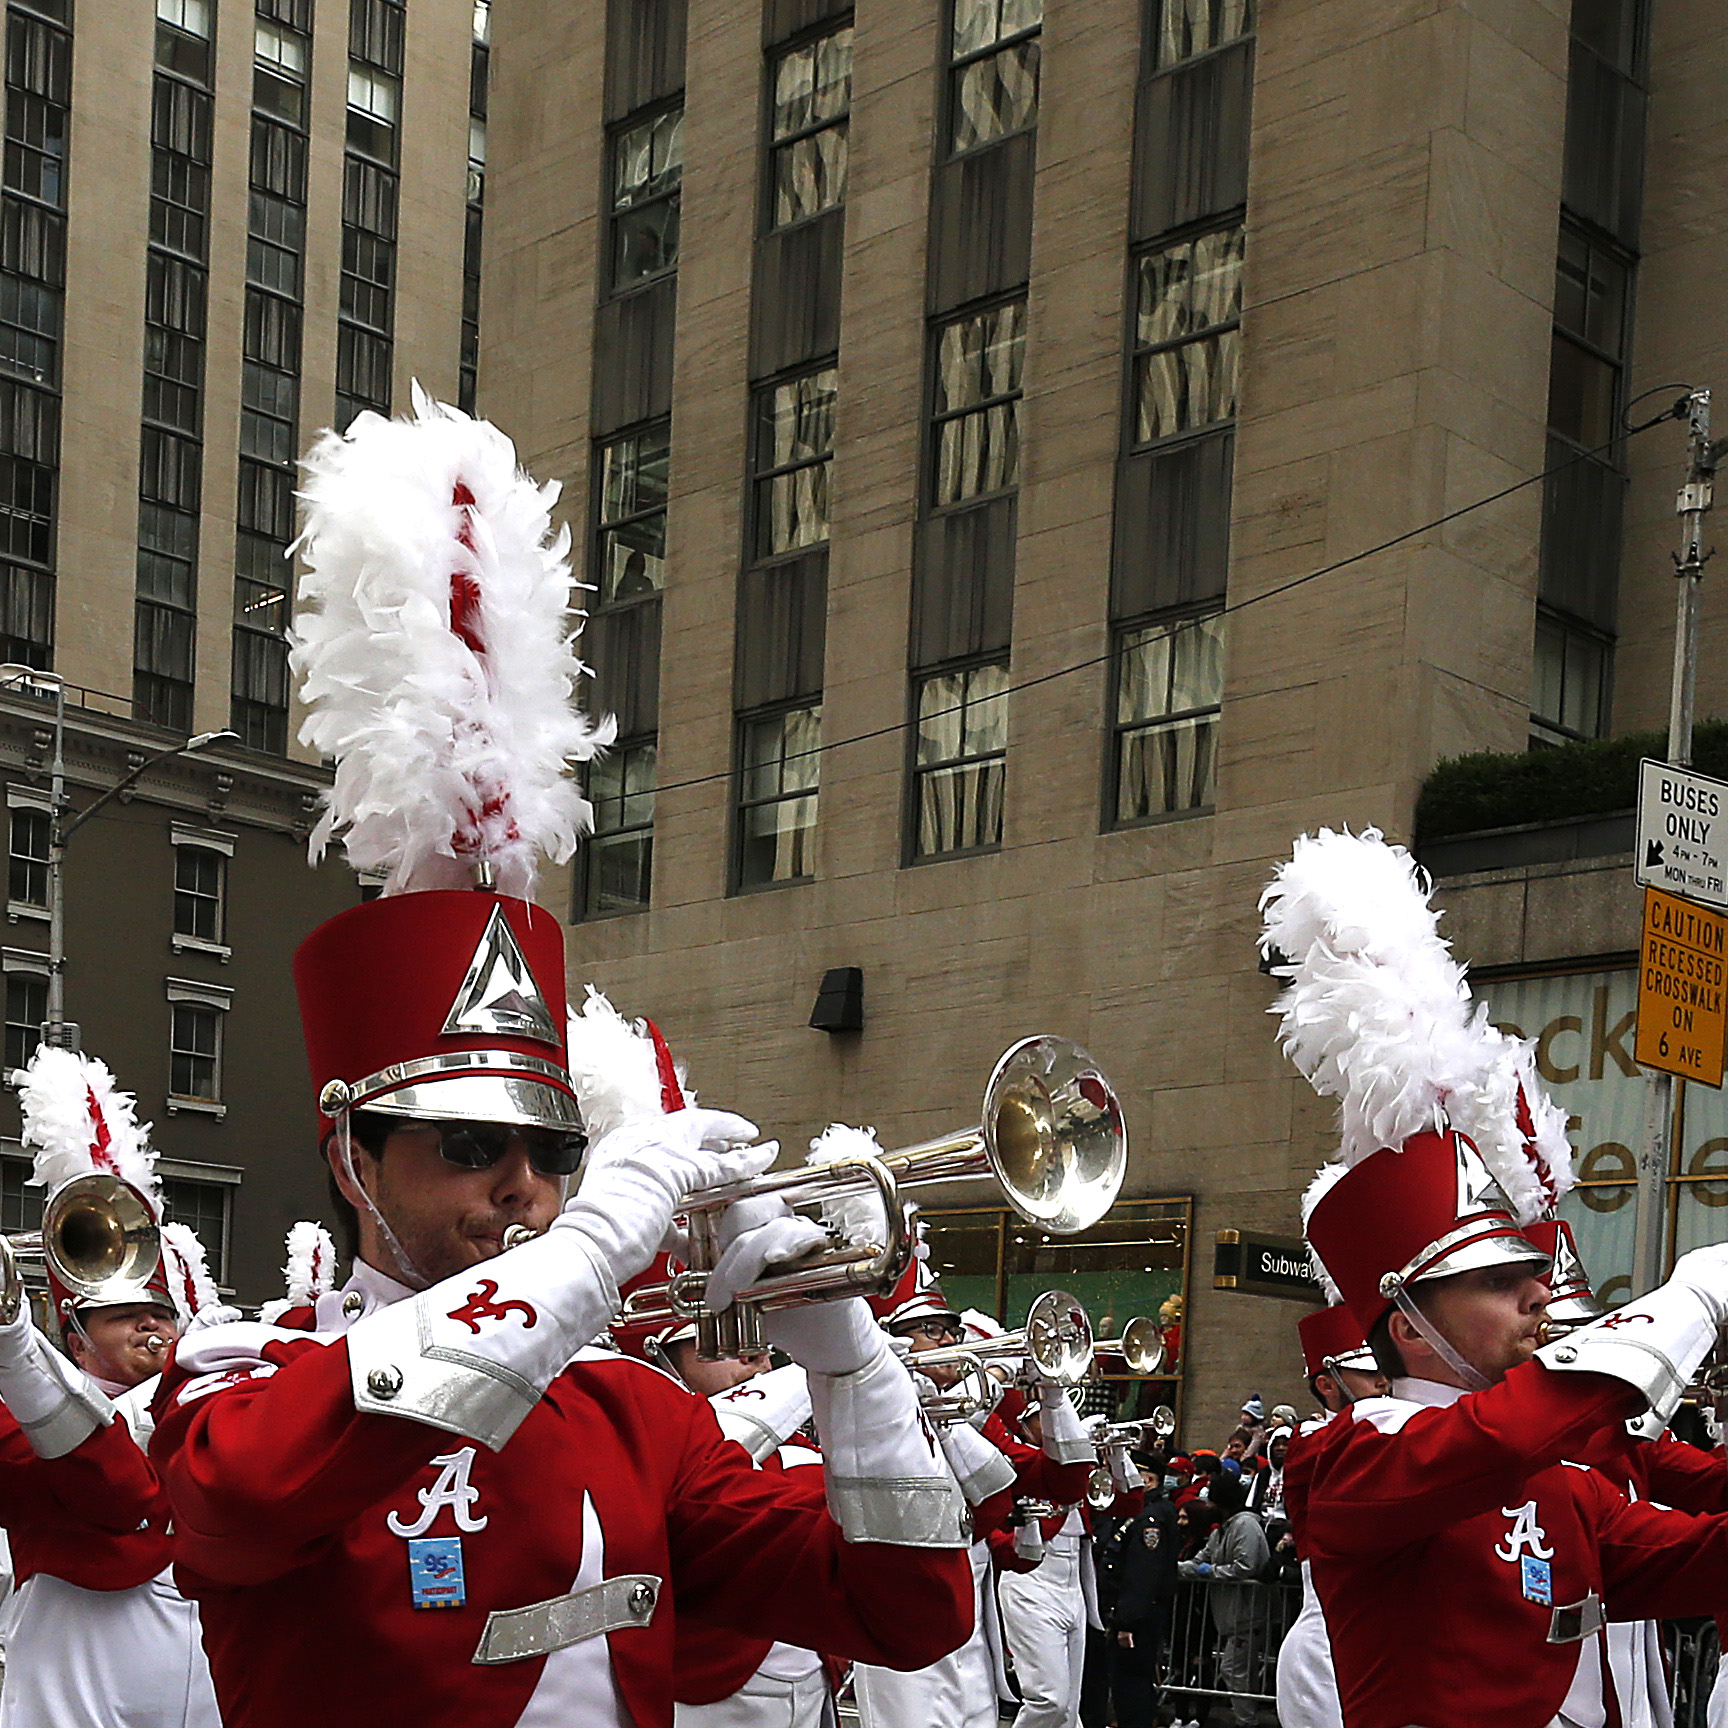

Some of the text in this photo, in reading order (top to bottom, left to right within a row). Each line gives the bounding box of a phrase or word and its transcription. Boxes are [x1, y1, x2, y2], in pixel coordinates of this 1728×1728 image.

[1661, 779, 1719, 816] BUSES
[1666, 813, 1711, 845] ONLY
[1665, 865, 1686, 883] MON
[1707, 876, 1723, 893] FRI
[1651, 902, 1724, 951] CAUTION
[1649, 940, 1722, 986] RECESSED
[1646, 968, 1721, 1014] CROSSWALK
[1673, 1006, 1693, 1033] ON
[1658, 1031, 1702, 1068] 6 AVE
[387, 1446, 488, 1538] A
[423, 1553, 449, 1573] 95
